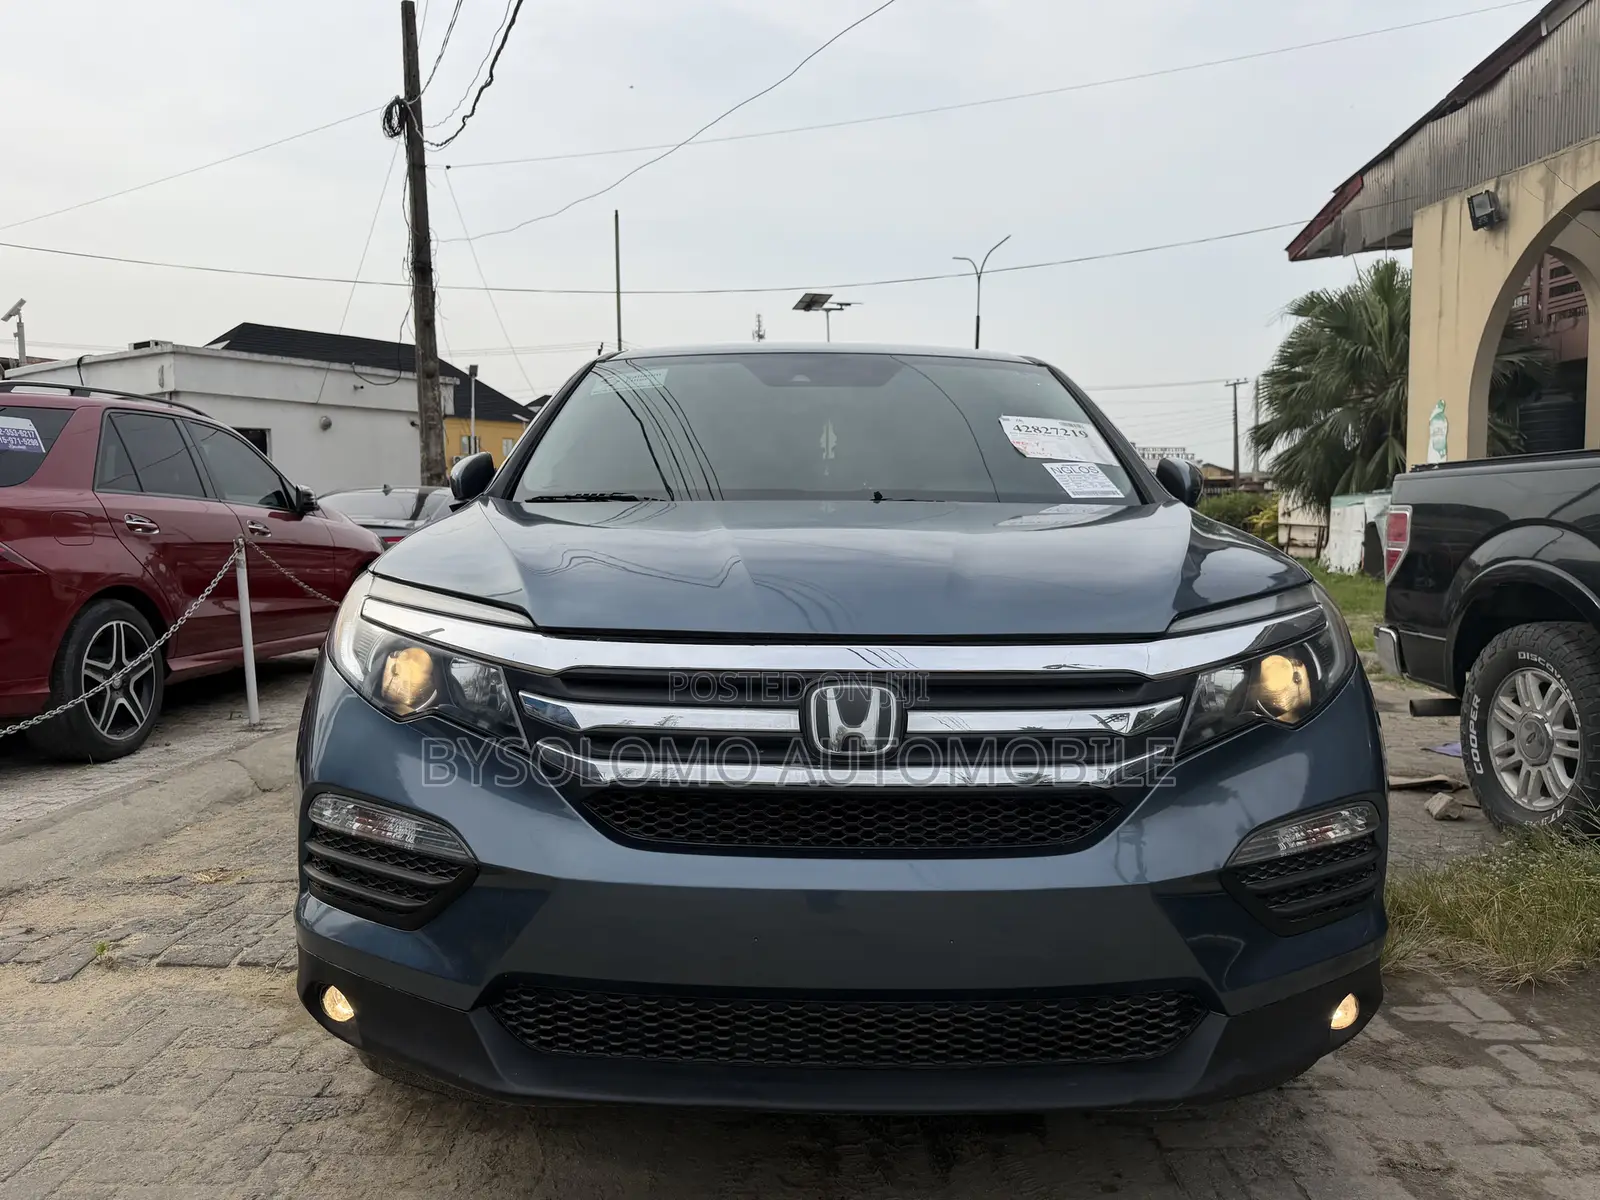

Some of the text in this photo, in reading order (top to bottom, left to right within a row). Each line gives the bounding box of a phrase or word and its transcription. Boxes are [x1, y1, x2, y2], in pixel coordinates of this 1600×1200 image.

[1013, 424, 1088, 438] 42827219
[1051, 466, 1099, 475] NGLOS
[1470, 694, 1483, 774] COOPER
